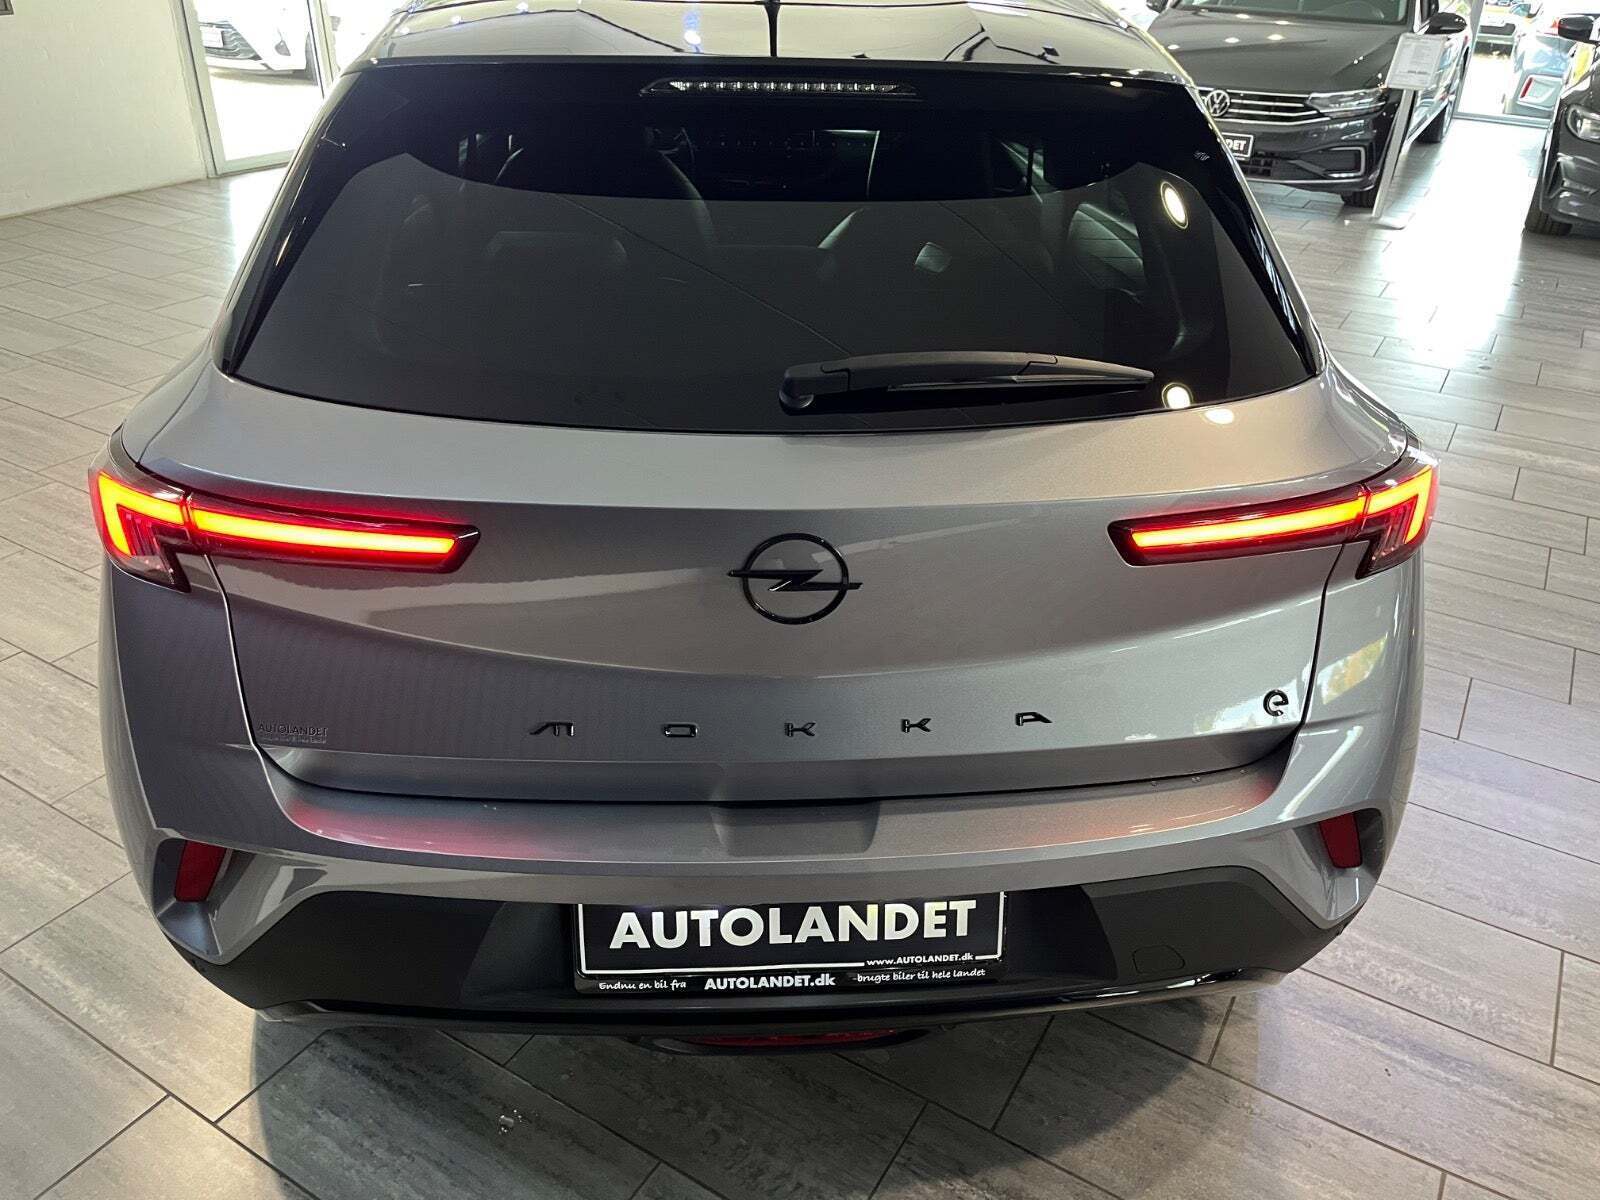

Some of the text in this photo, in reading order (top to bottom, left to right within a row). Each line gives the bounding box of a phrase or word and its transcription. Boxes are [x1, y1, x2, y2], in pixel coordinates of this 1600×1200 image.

[258, 724, 328, 736] AUTOLANDET
[529, 711, 1052, 738] MOKKA
[609, 900, 977, 949] AUTOLANDET
[867, 953, 973, 965] www.AUTOLANDET.dk
[599, 981, 636, 990] Endnu
[654, 980, 668, 988] bil
[670, 979, 687, 991] fra
[704, 973, 836, 990] AUTOLANDET.dk
[893, 971, 915, 981] biler
[917, 970, 929, 979] til
[932, 970, 951, 979] hele
[953, 968, 986, 977] landet
